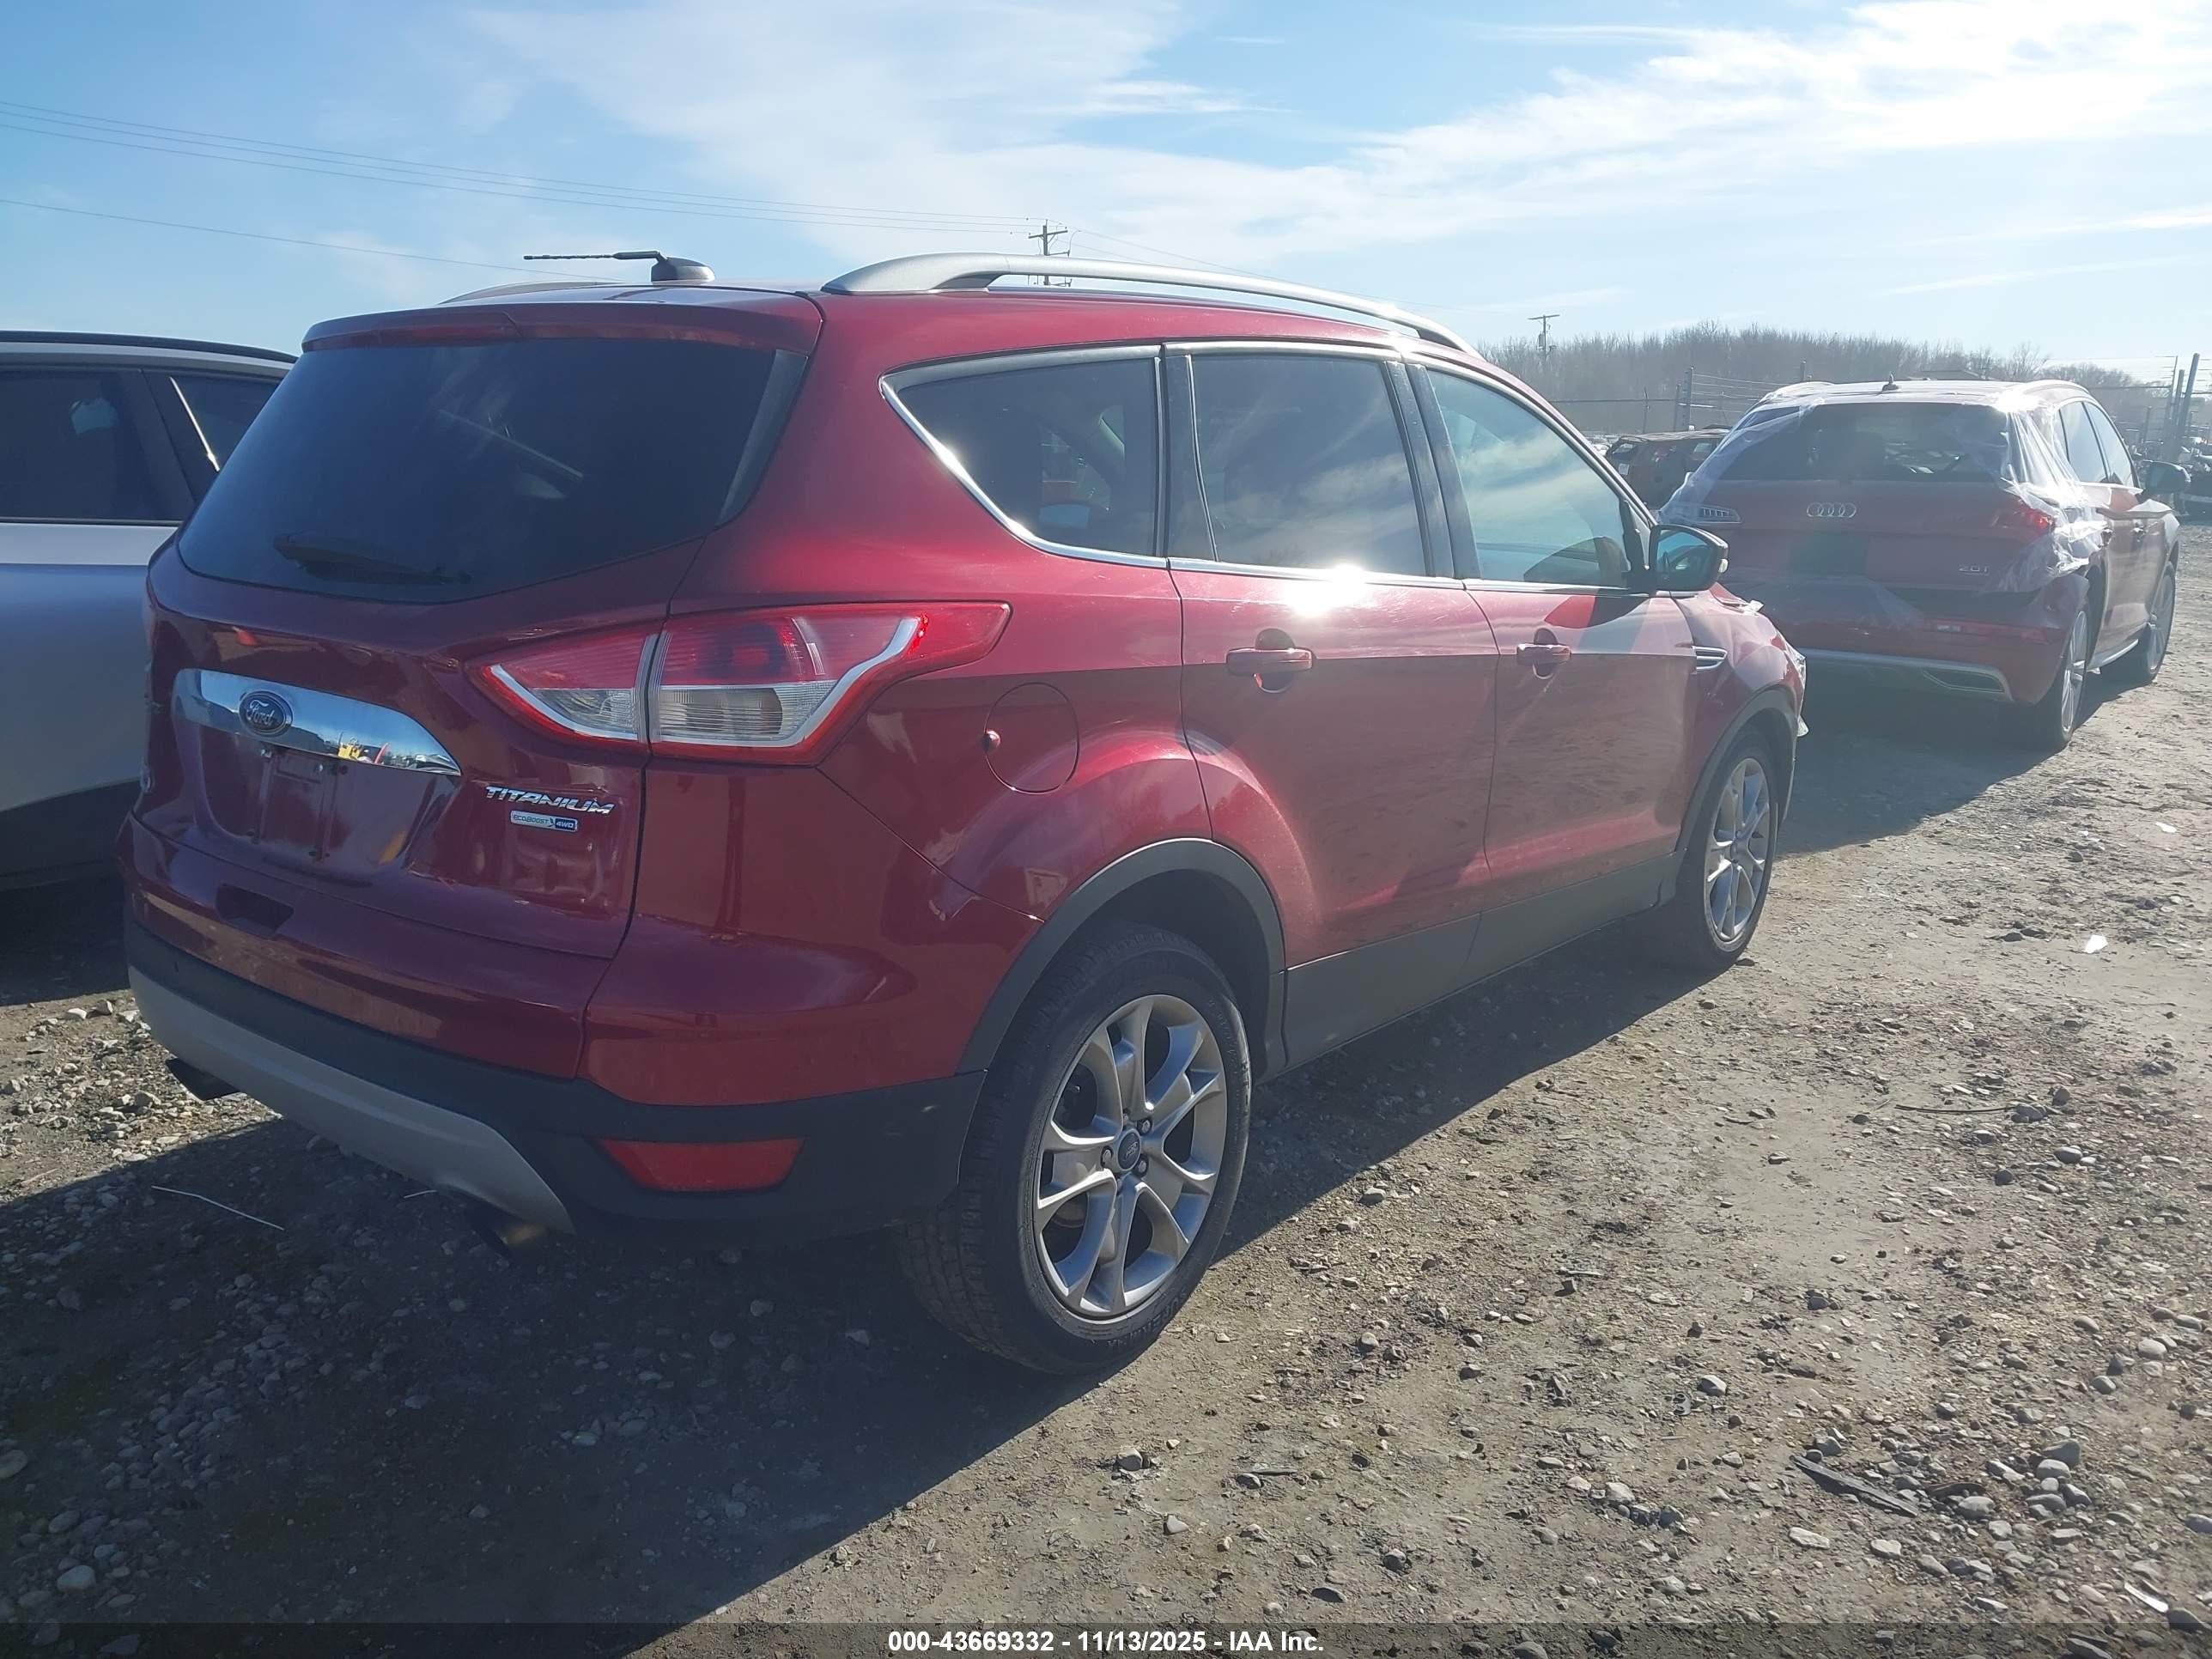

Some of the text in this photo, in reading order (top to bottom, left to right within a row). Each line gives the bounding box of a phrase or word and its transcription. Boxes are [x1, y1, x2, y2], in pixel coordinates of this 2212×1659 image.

[246, 699, 275, 726] Ford
[485, 785, 616, 815] TITANIUM
[556, 820, 574, 830] 4WD
